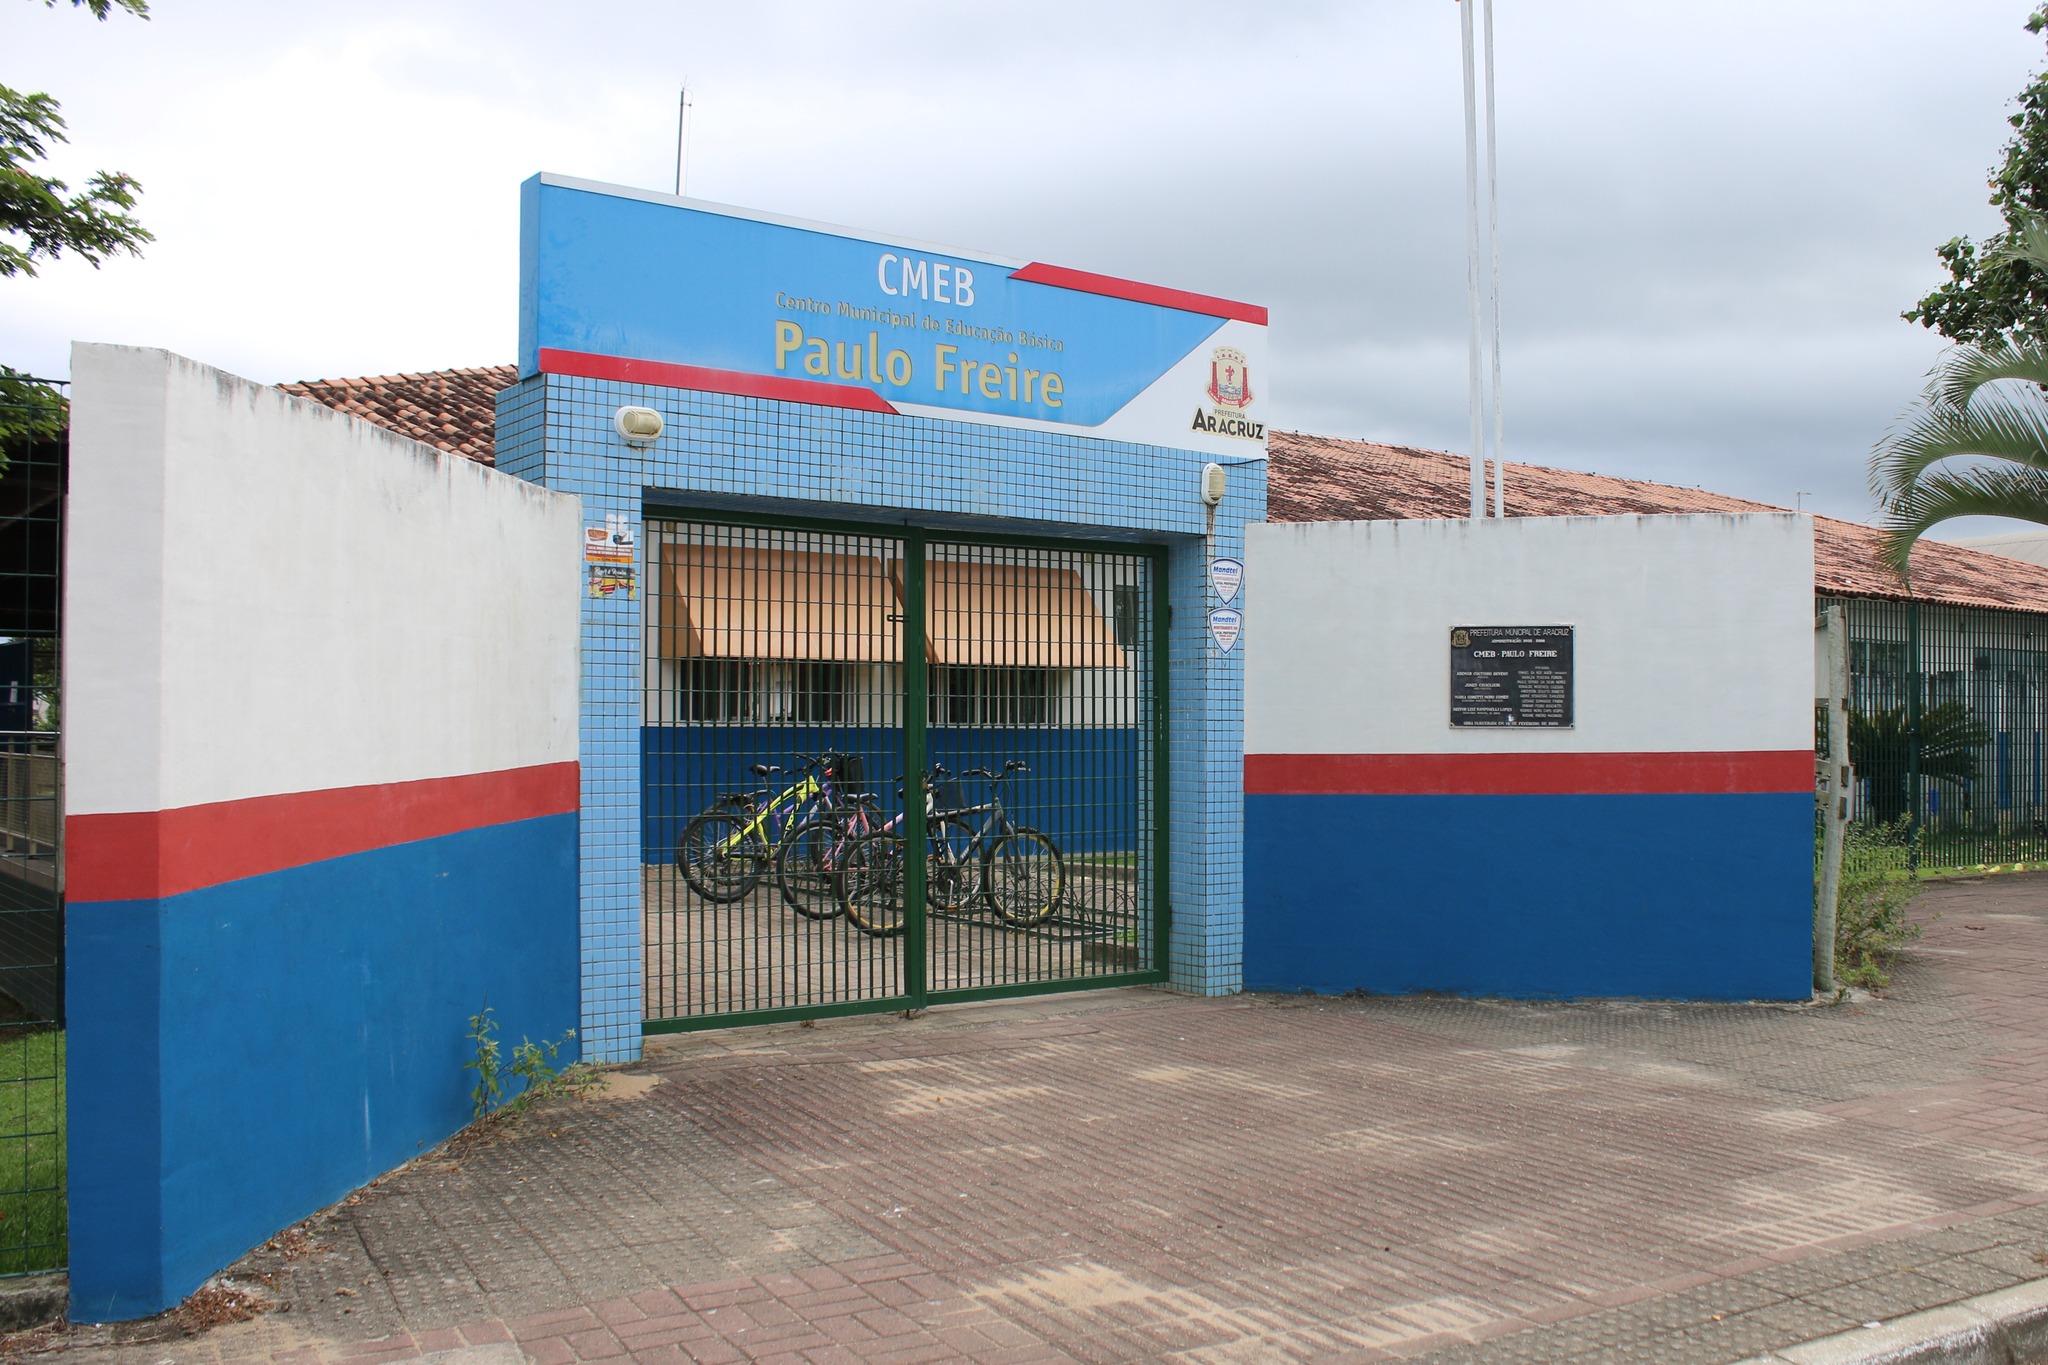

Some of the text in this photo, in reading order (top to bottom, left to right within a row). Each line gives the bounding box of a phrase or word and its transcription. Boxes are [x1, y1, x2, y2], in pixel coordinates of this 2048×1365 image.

[877, 253, 976, 307] CMEB
[775, 292, 1064, 351] Centro Municipal de Educação Básica
[775, 319, 1065, 408] Paulo Freire
[1192, 407, 1264, 440] ARACRUZ
[1214, 408, 1246, 420] PREFEITURA
